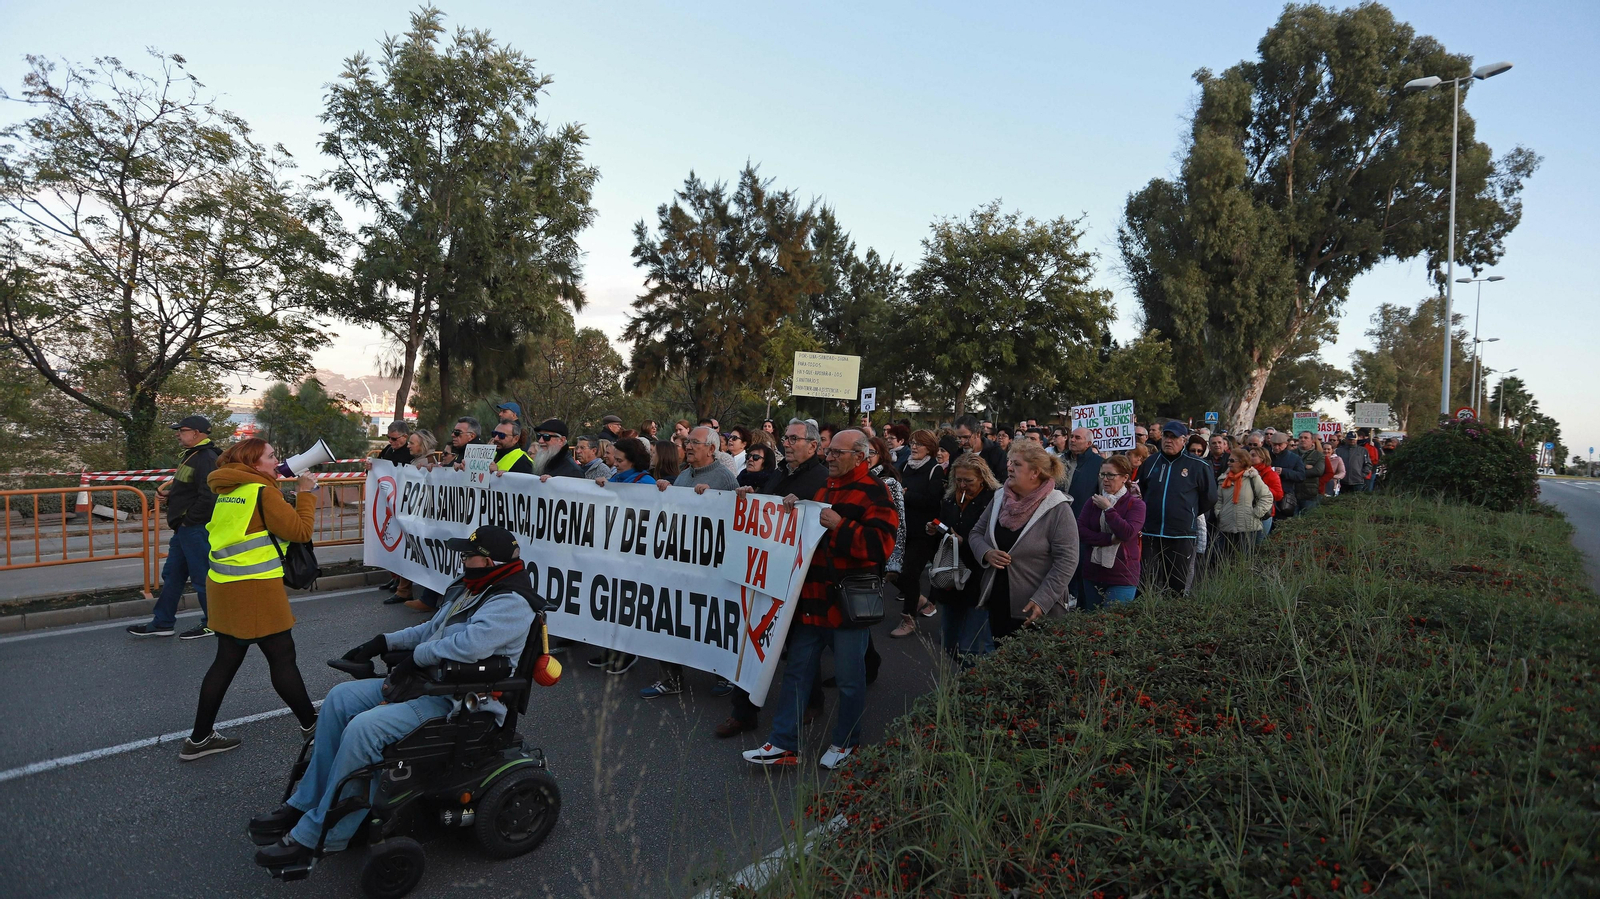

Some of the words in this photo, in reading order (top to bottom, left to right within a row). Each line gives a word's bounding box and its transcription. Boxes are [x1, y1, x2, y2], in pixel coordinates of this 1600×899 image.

[1074, 406, 1095, 420] BASTA
[1099, 405, 1107, 417] DE
[1112, 403, 1132, 415] ECHAR
[1086, 418, 1099, 428] LOS
[1105, 426, 1119, 438] CON
[1122, 426, 1131, 436] EL
[469, 459, 489, 471] GRACIAS
[470, 472, 477, 482] DE
[400, 481, 426, 516] POR
[437, 485, 475, 525] SANIDD
[604, 506, 618, 550] Y
[620, 508, 650, 556] DE
[733, 496, 798, 547] BASTA
[745, 545, 769, 589] YA
[546, 566, 582, 615] DE
[590, 574, 740, 654] GIBRALTAR
